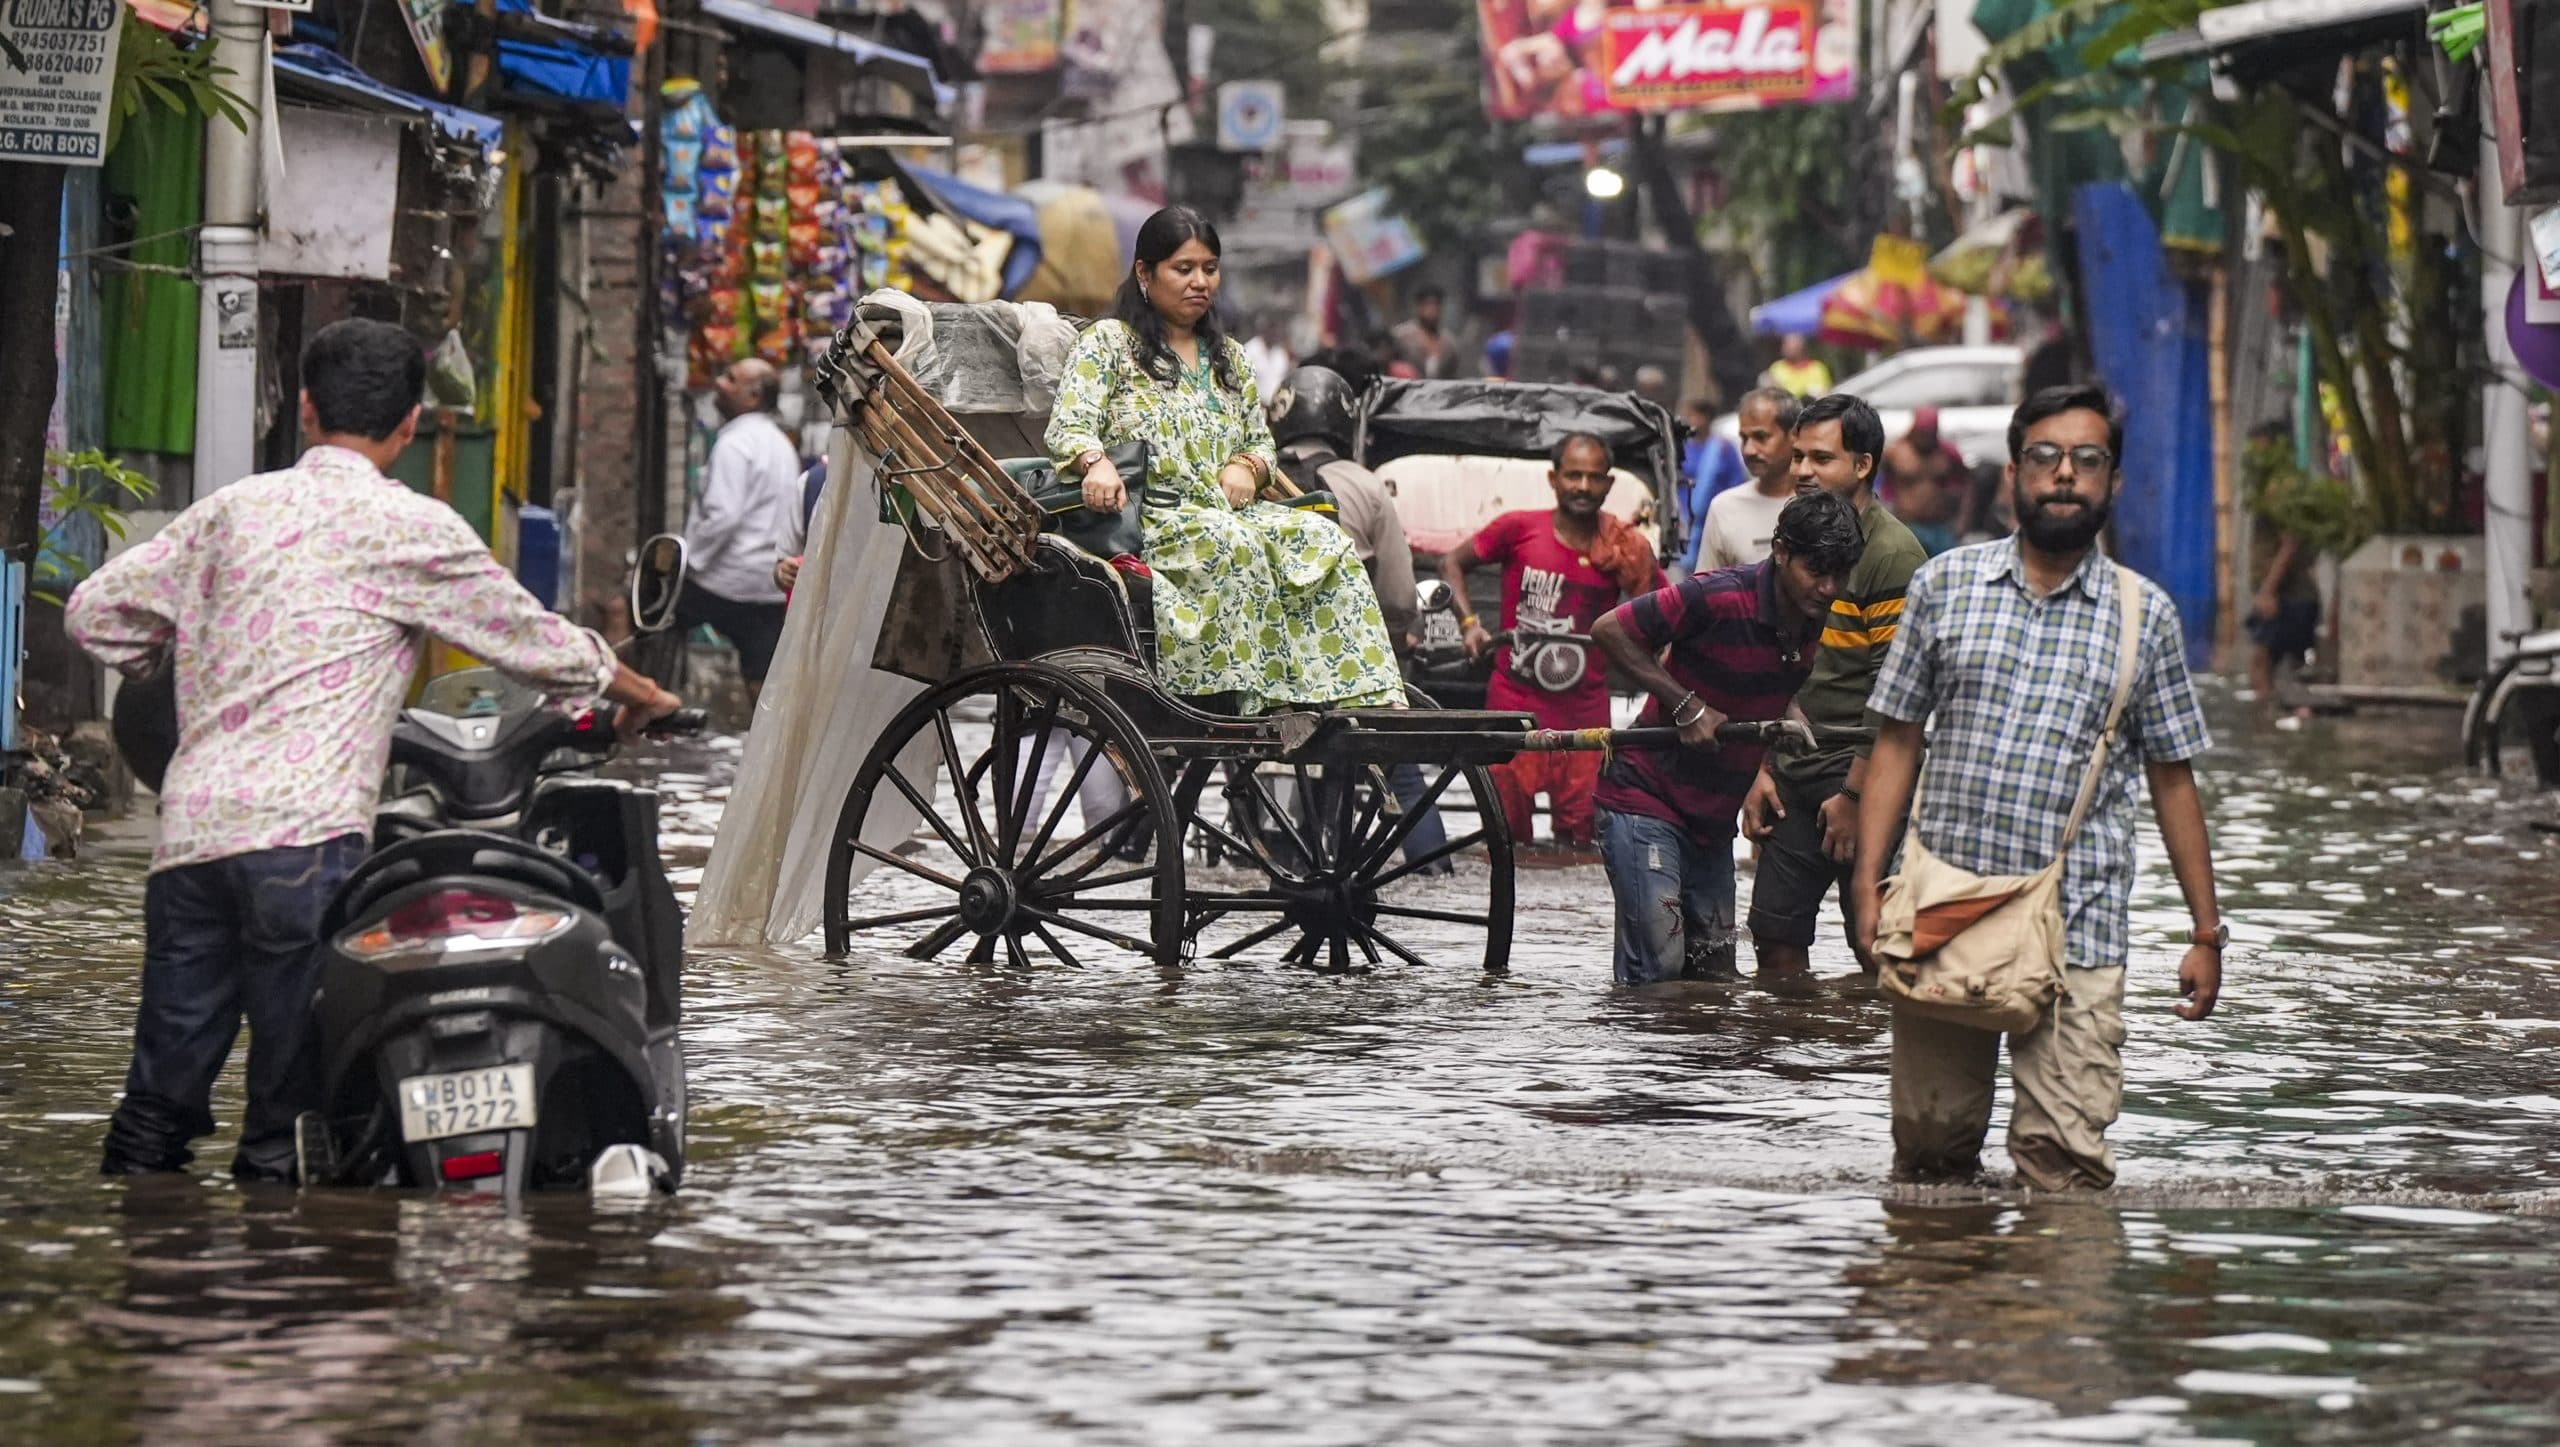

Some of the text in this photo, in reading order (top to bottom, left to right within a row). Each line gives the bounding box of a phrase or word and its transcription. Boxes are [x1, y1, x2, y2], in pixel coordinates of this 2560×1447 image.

[14, 0, 110, 30] RUDRA'S PG
[1611, 7, 1807, 85] Mala
[38, 74, 64, 85] NEAR
[23, 102, 54, 113] METRO
[57, 104, 97, 115] STATION
[59, 90, 102, 102] COLLEGE
[3, 114, 46, 125] KOLKATA
[23, 132, 54, 152] FOR
[57, 135, 97, 155] BOYS
[1520, 565, 1566, 598] PEDAL
[423, 1071, 513, 1106] WB01A
[425, 1098, 519, 1136] R7272
